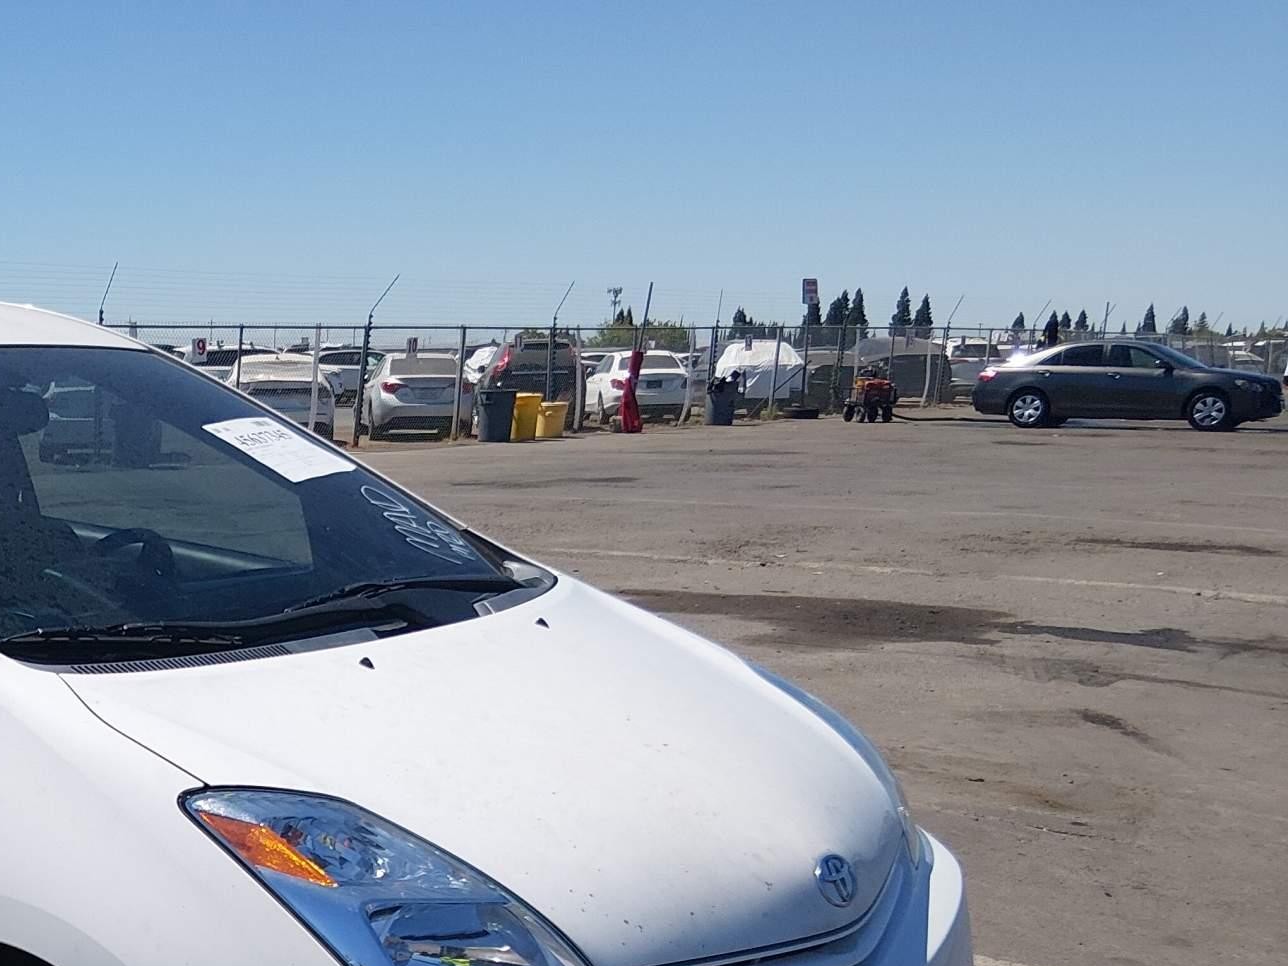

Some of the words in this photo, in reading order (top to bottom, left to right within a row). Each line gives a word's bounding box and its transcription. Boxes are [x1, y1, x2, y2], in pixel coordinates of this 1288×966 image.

[196, 339, 206, 356] 9
[407, 337, 419, 353] 10
[234, 429, 293, 447] 45637345
